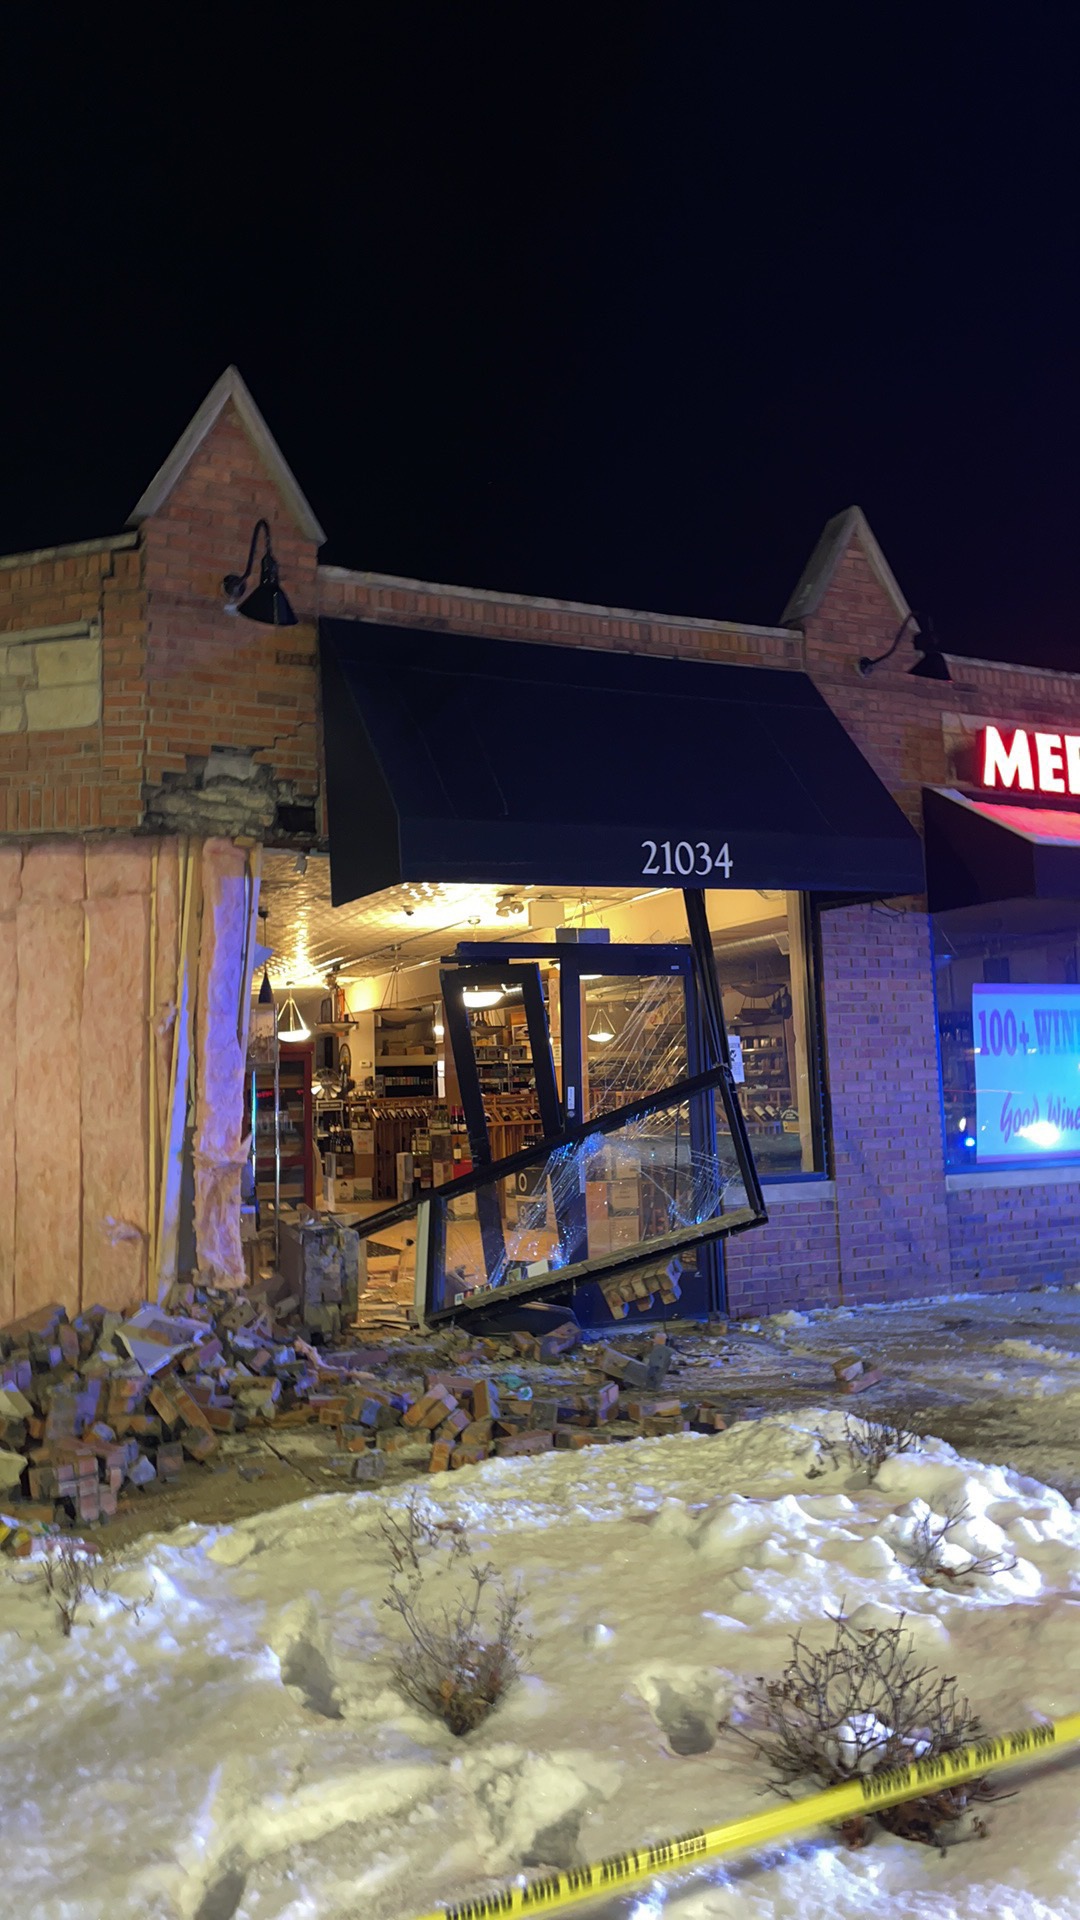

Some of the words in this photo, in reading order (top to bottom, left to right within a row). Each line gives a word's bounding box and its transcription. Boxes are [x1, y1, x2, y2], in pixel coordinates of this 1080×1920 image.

[641, 840, 734, 879] 21034
[978, 1009, 1029, 1056] 100+
[1033, 1009, 1080, 1056] WIN
[1000, 1092, 1040, 1143] Good
